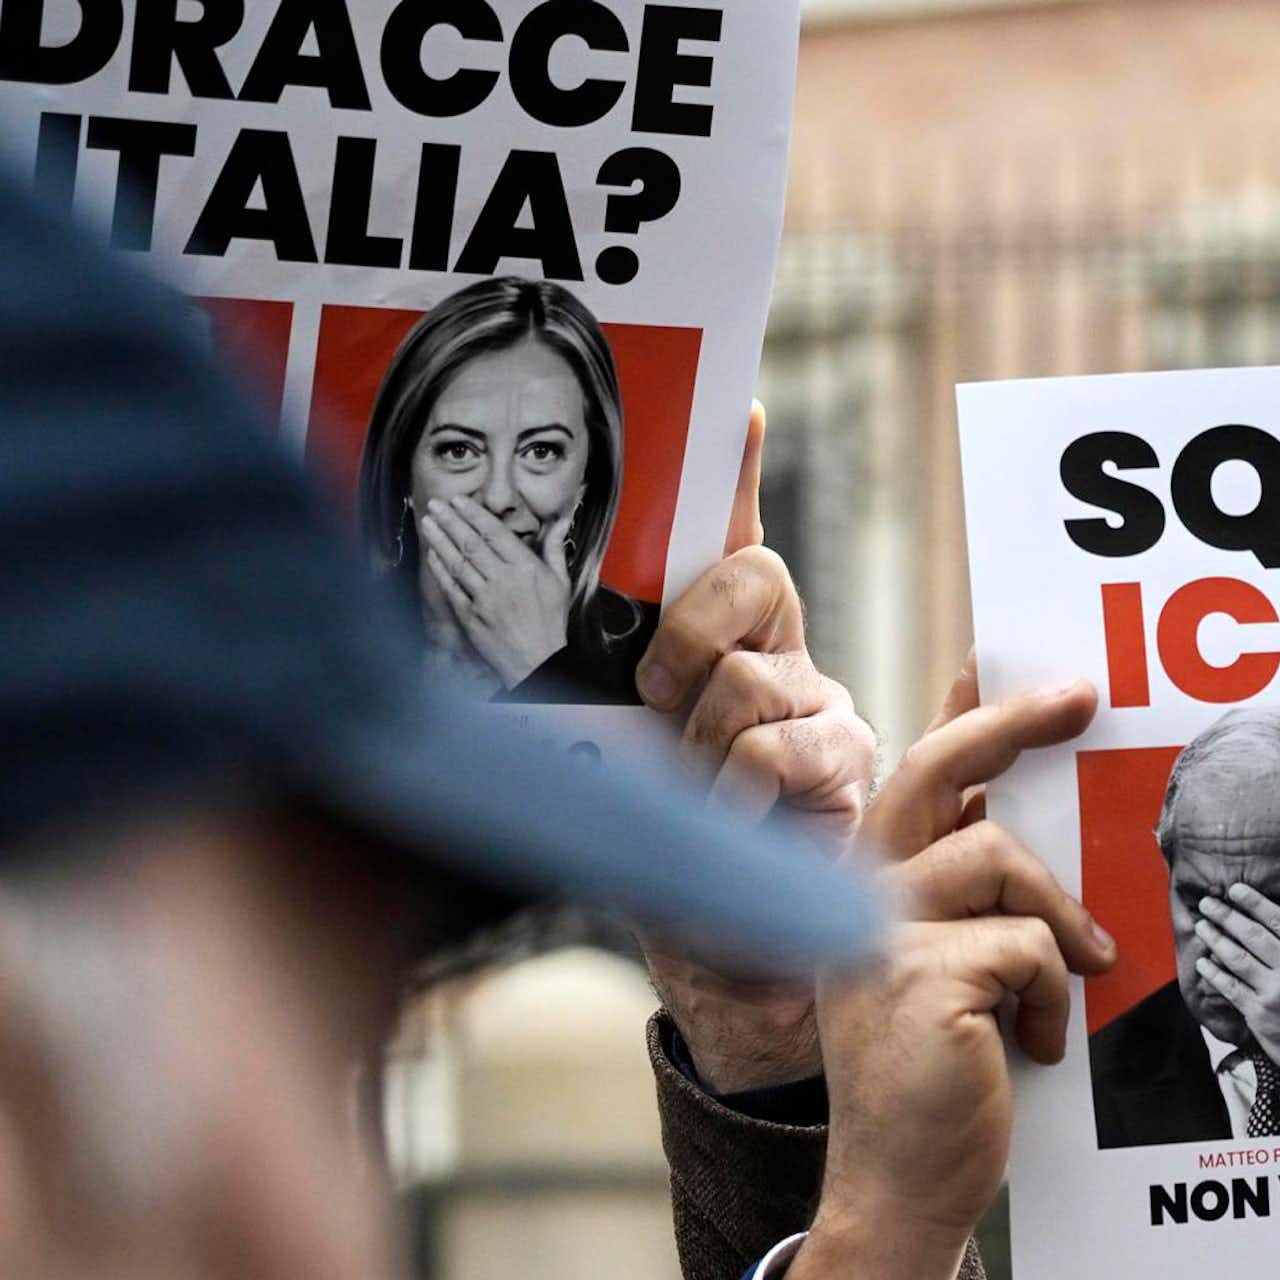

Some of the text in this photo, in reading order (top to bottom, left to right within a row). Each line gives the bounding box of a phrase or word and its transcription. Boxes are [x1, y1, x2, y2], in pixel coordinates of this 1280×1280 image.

[33, 112, 681, 286] ITALIA?
[1199, 1149, 1270, 1168] MATTEO
[1149, 1176, 1270, 1226] NON
